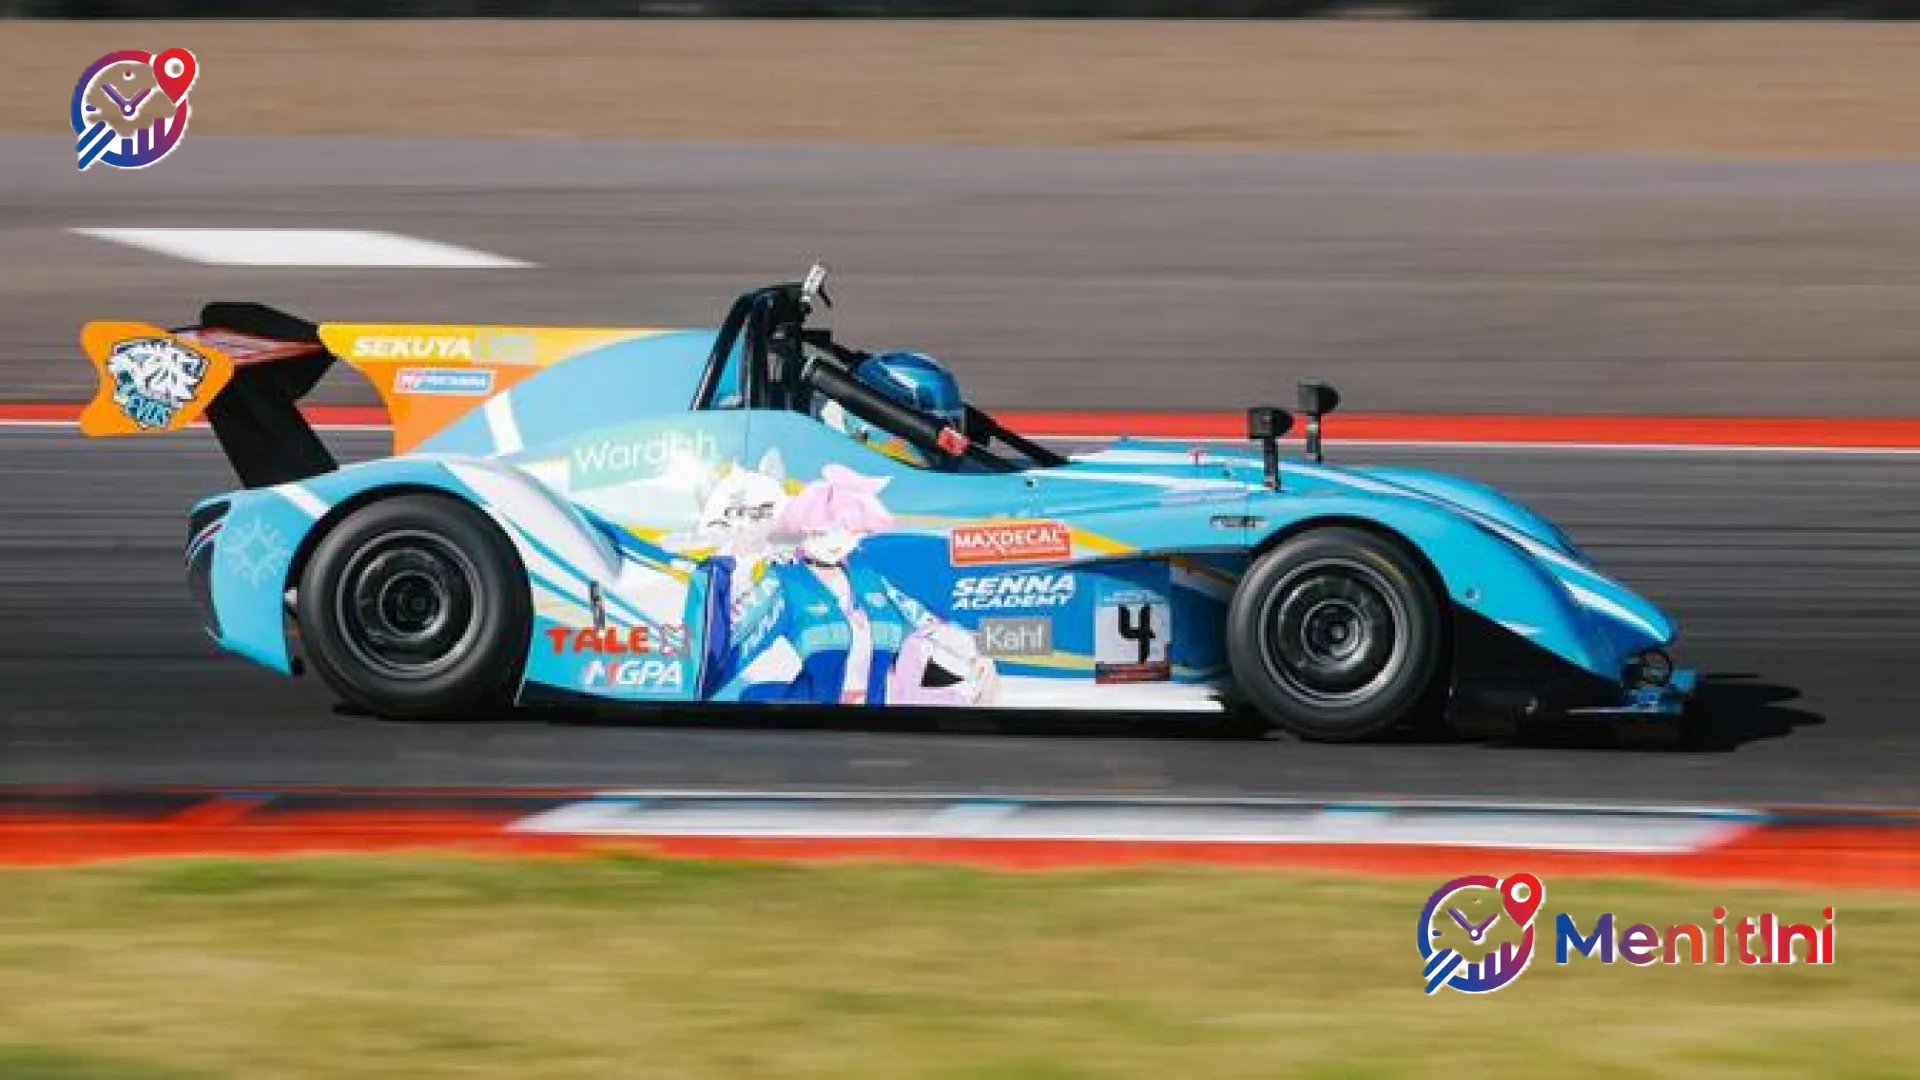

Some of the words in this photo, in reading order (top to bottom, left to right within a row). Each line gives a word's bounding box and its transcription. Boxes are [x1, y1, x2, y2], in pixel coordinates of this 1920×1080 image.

[353, 335, 473, 358] SEKUYA
[954, 526, 1064, 549] MAXDECAL
[952, 572, 1077, 597] SENNA
[952, 592, 1071, 611] ACADEMY
[546, 624, 650, 656] TALE
[1117, 603, 1156, 664] 4
